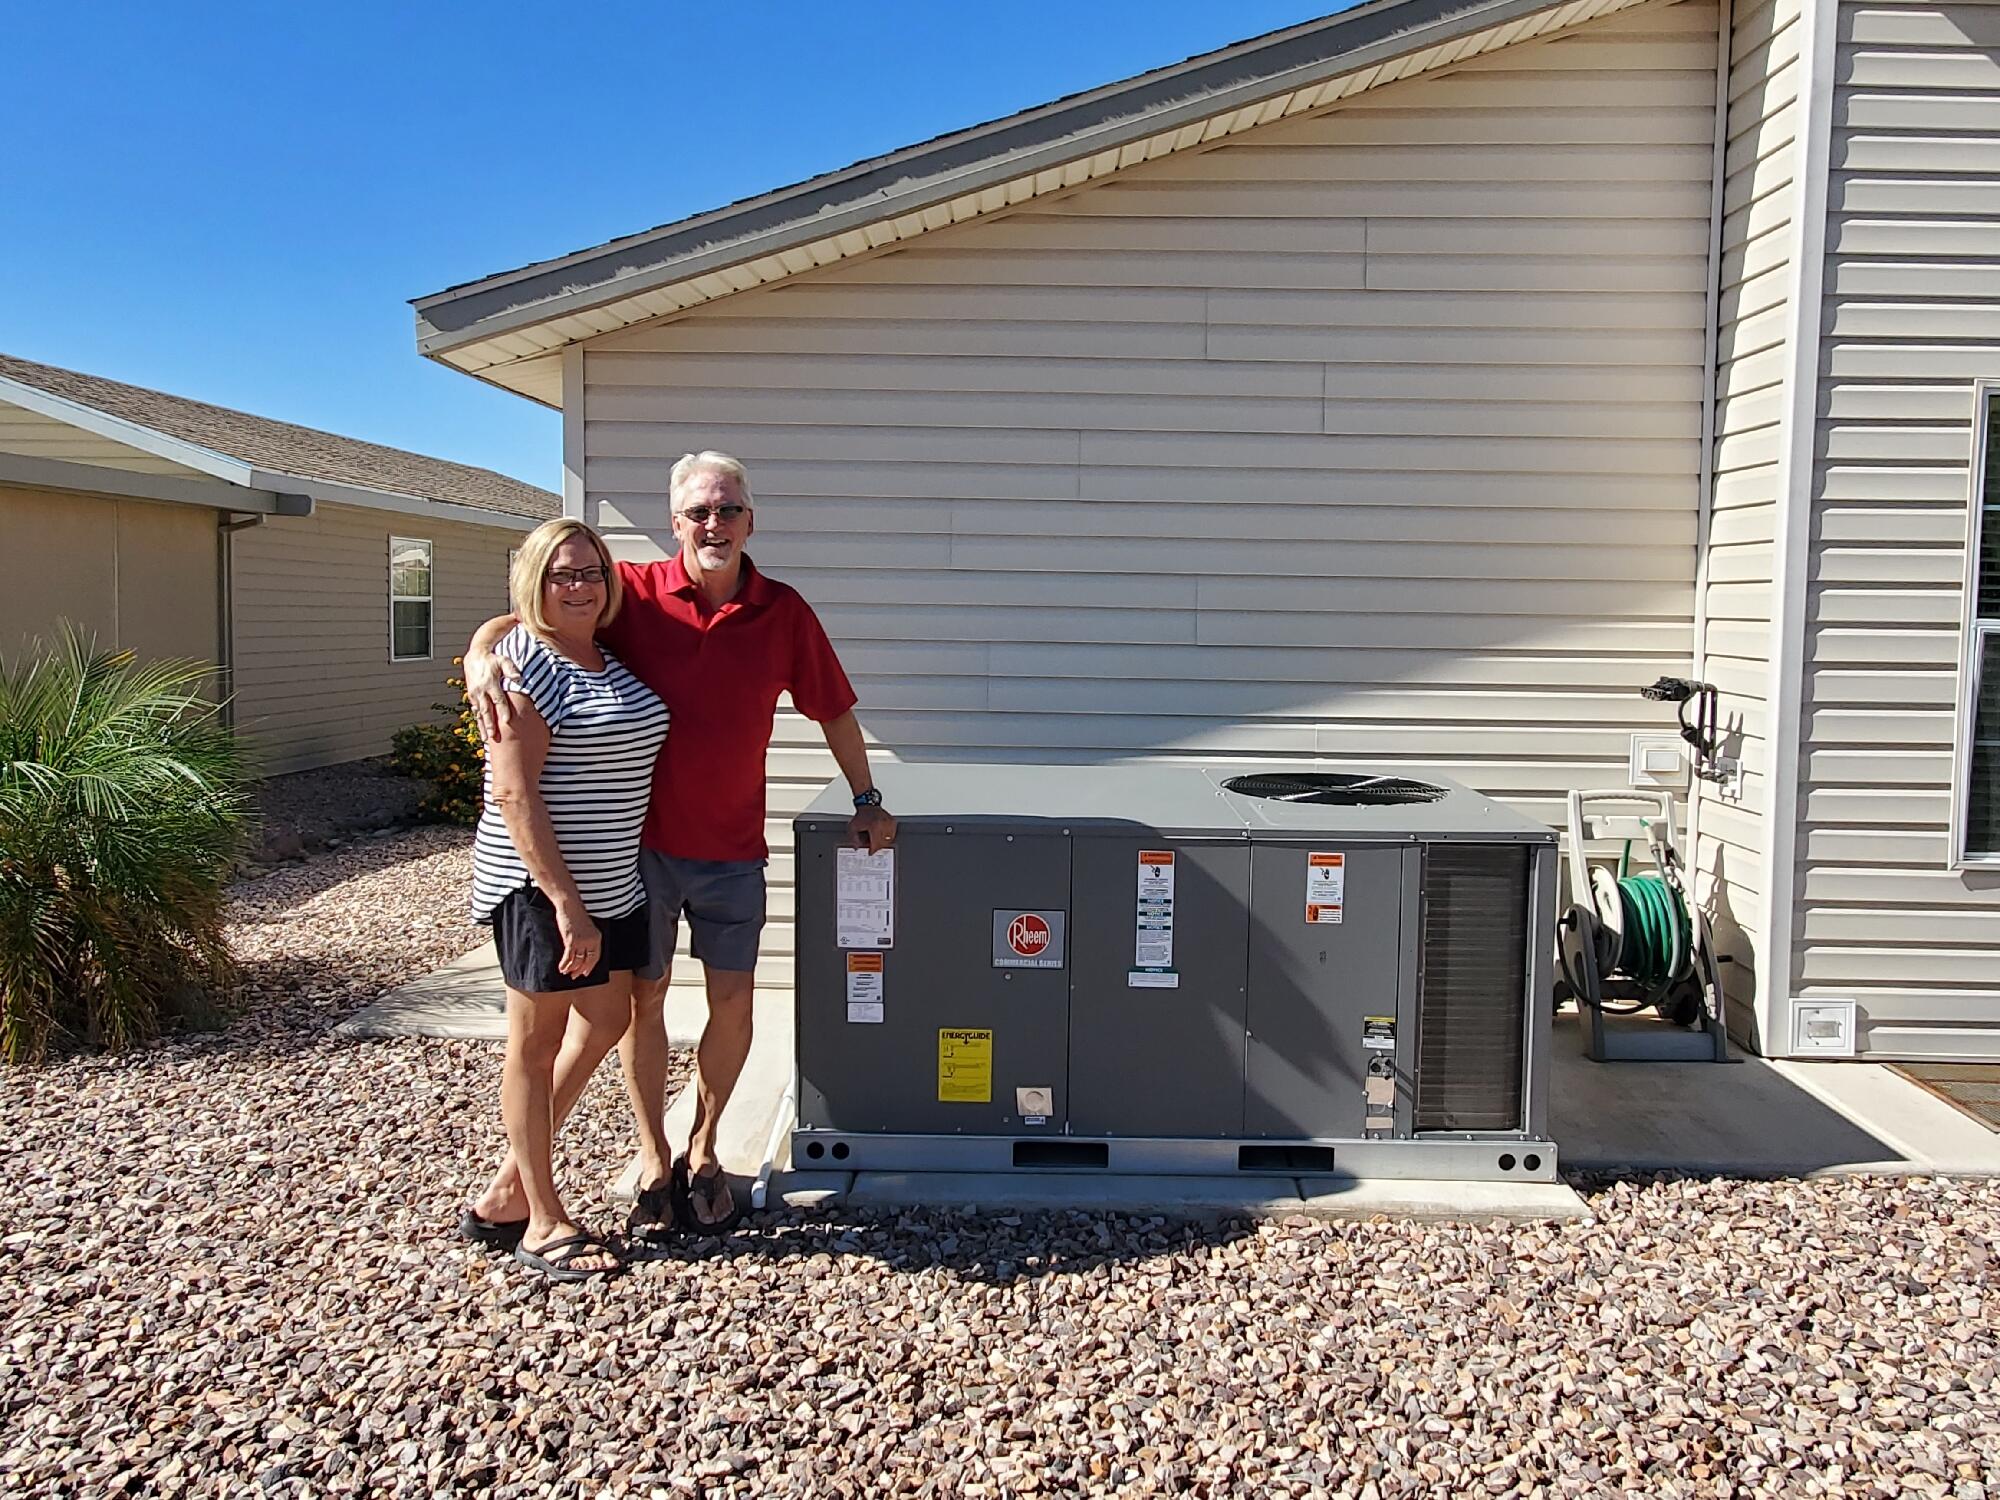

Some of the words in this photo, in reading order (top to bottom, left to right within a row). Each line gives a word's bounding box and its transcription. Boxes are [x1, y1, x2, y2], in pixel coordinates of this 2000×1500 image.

[1013, 914, 1047, 949] Rheem
[994, 958, 1038, 967] COMMERCIAL
[1039, 959, 1062, 968] SERIES
